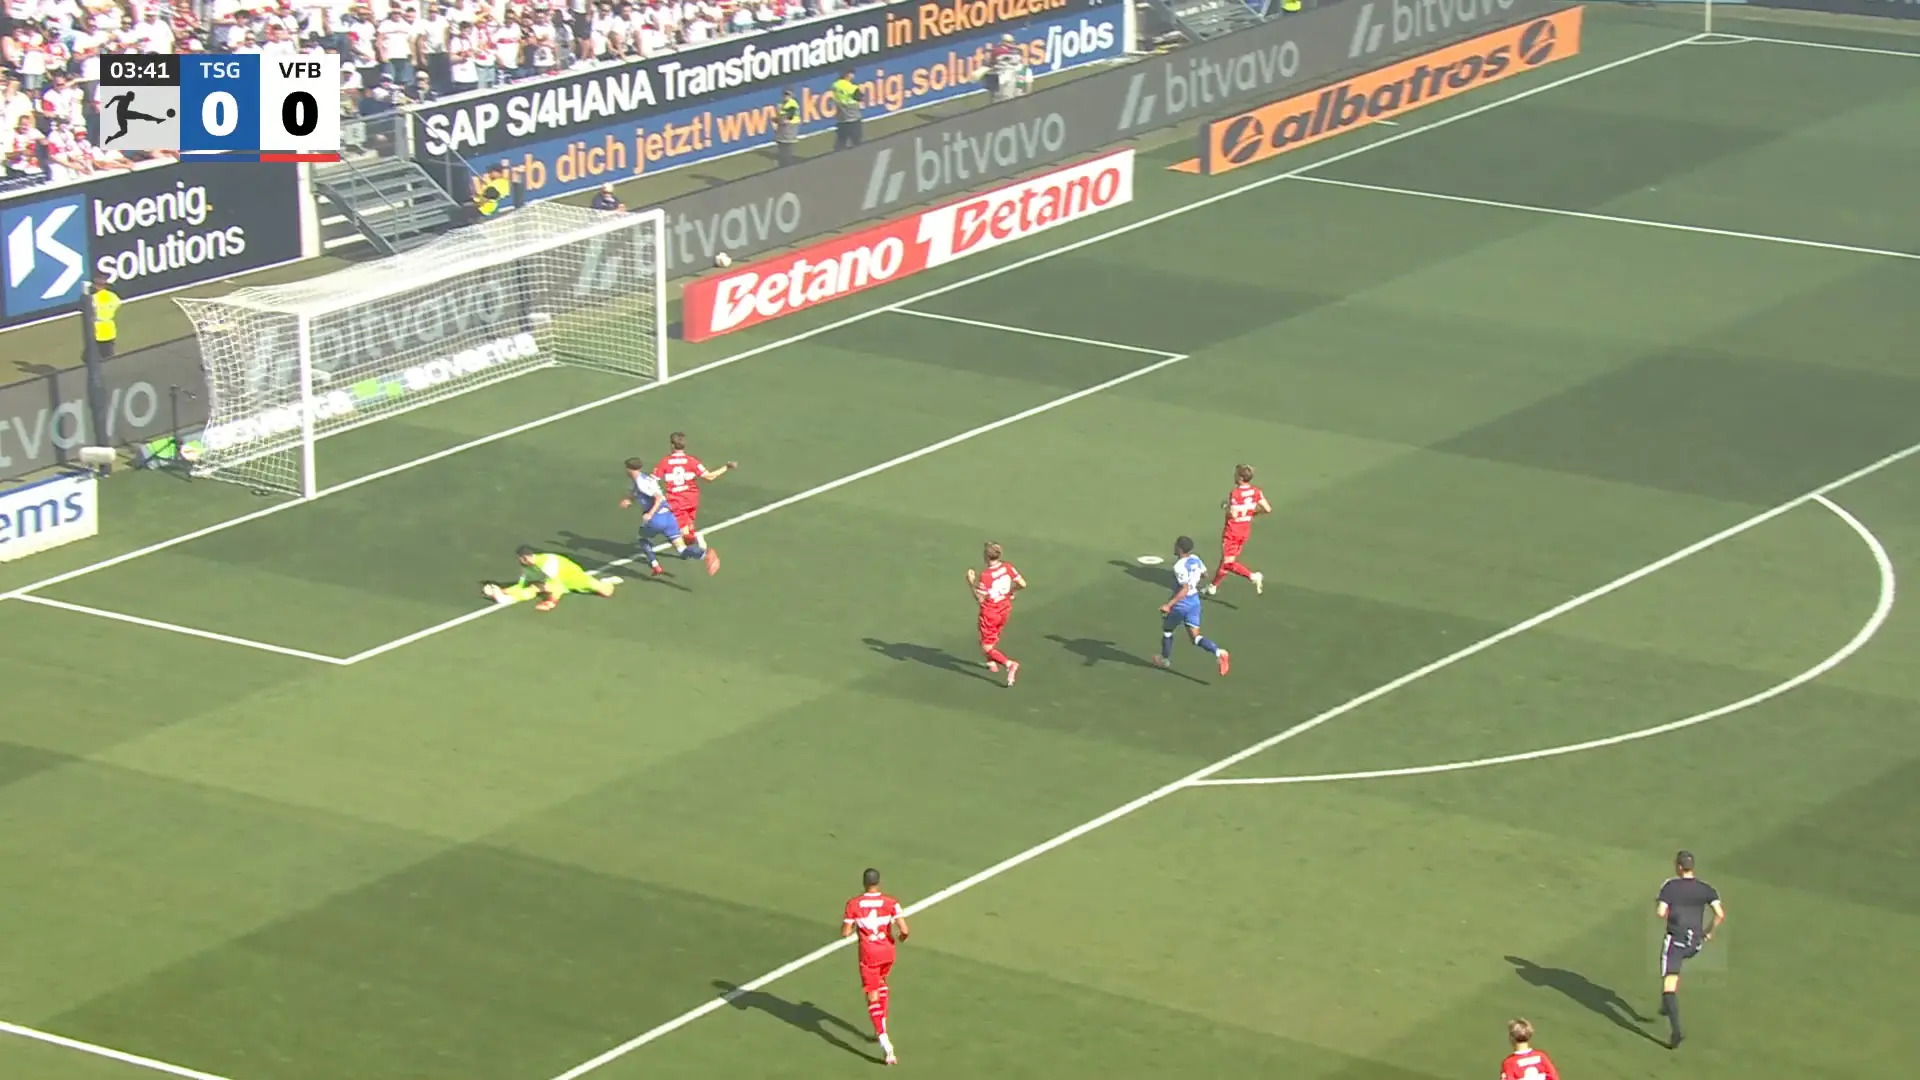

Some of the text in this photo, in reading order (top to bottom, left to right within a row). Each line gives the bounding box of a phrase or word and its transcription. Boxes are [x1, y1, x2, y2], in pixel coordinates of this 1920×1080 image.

[425, 103, 499, 156] SAP
[506, 70, 657, 137] S/4HANA
[658, 24, 879, 101] Transformation
[886, 13, 913, 48] in
[1166, 38, 1299, 115] bitvavo
[1271, 41, 1510, 149] albatros
[556, 135, 626, 184] dich
[633, 111, 712, 175] jetzt!
[915, 112, 1066, 193] bitvavo
[97, 225, 246, 284] solutions
[710, 236, 904, 333] Betano
[950, 166, 1121, 255] Betano
